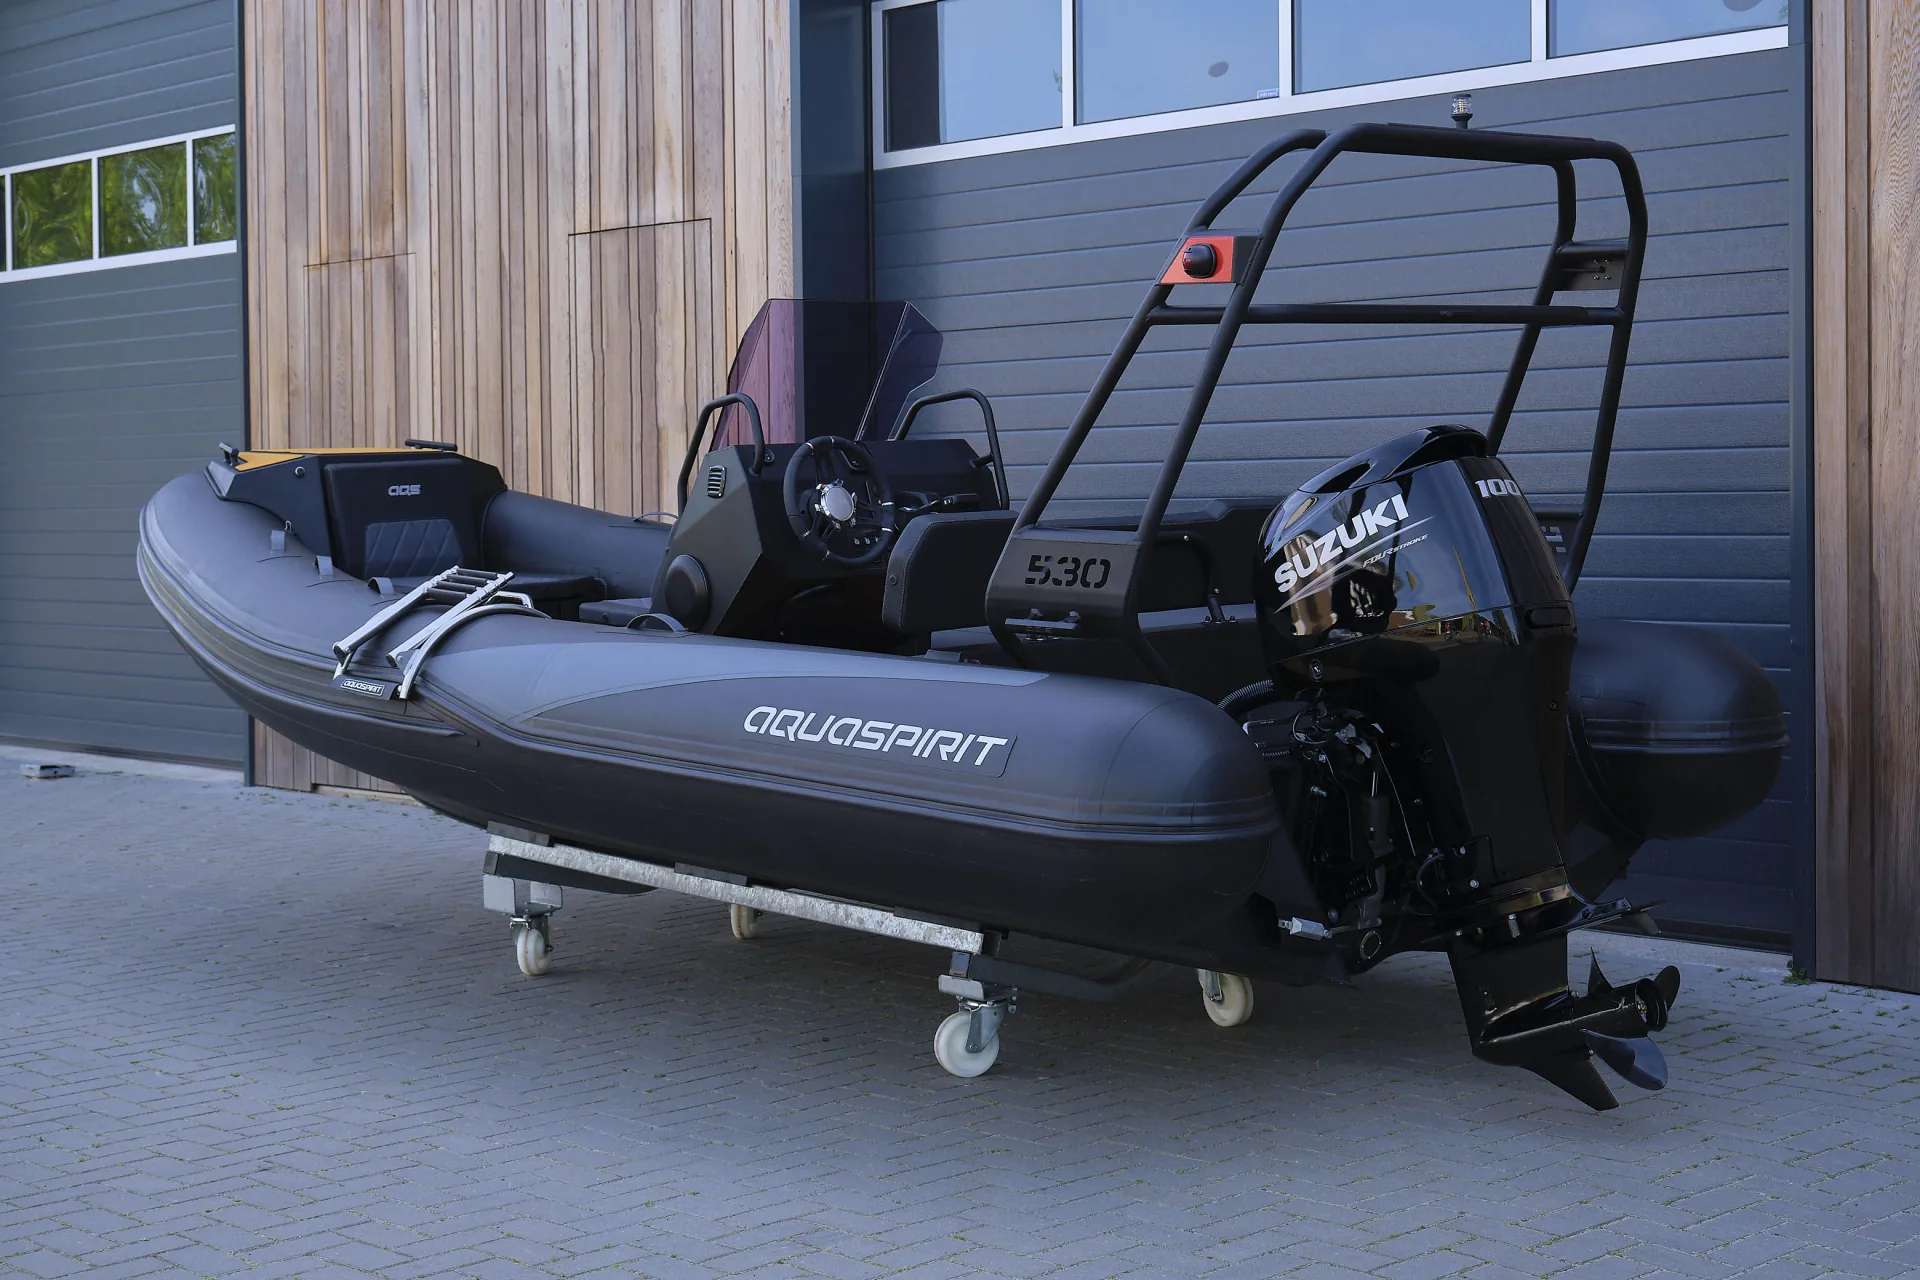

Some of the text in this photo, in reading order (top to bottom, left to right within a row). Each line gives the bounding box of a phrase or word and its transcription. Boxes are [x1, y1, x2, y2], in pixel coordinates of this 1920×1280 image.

[1475, 478, 1522, 498] 100
[1274, 493, 1410, 593] SUZUKI
[1024, 554, 1111, 589] 530
[743, 705, 1009, 766] AQUASPIRIT
